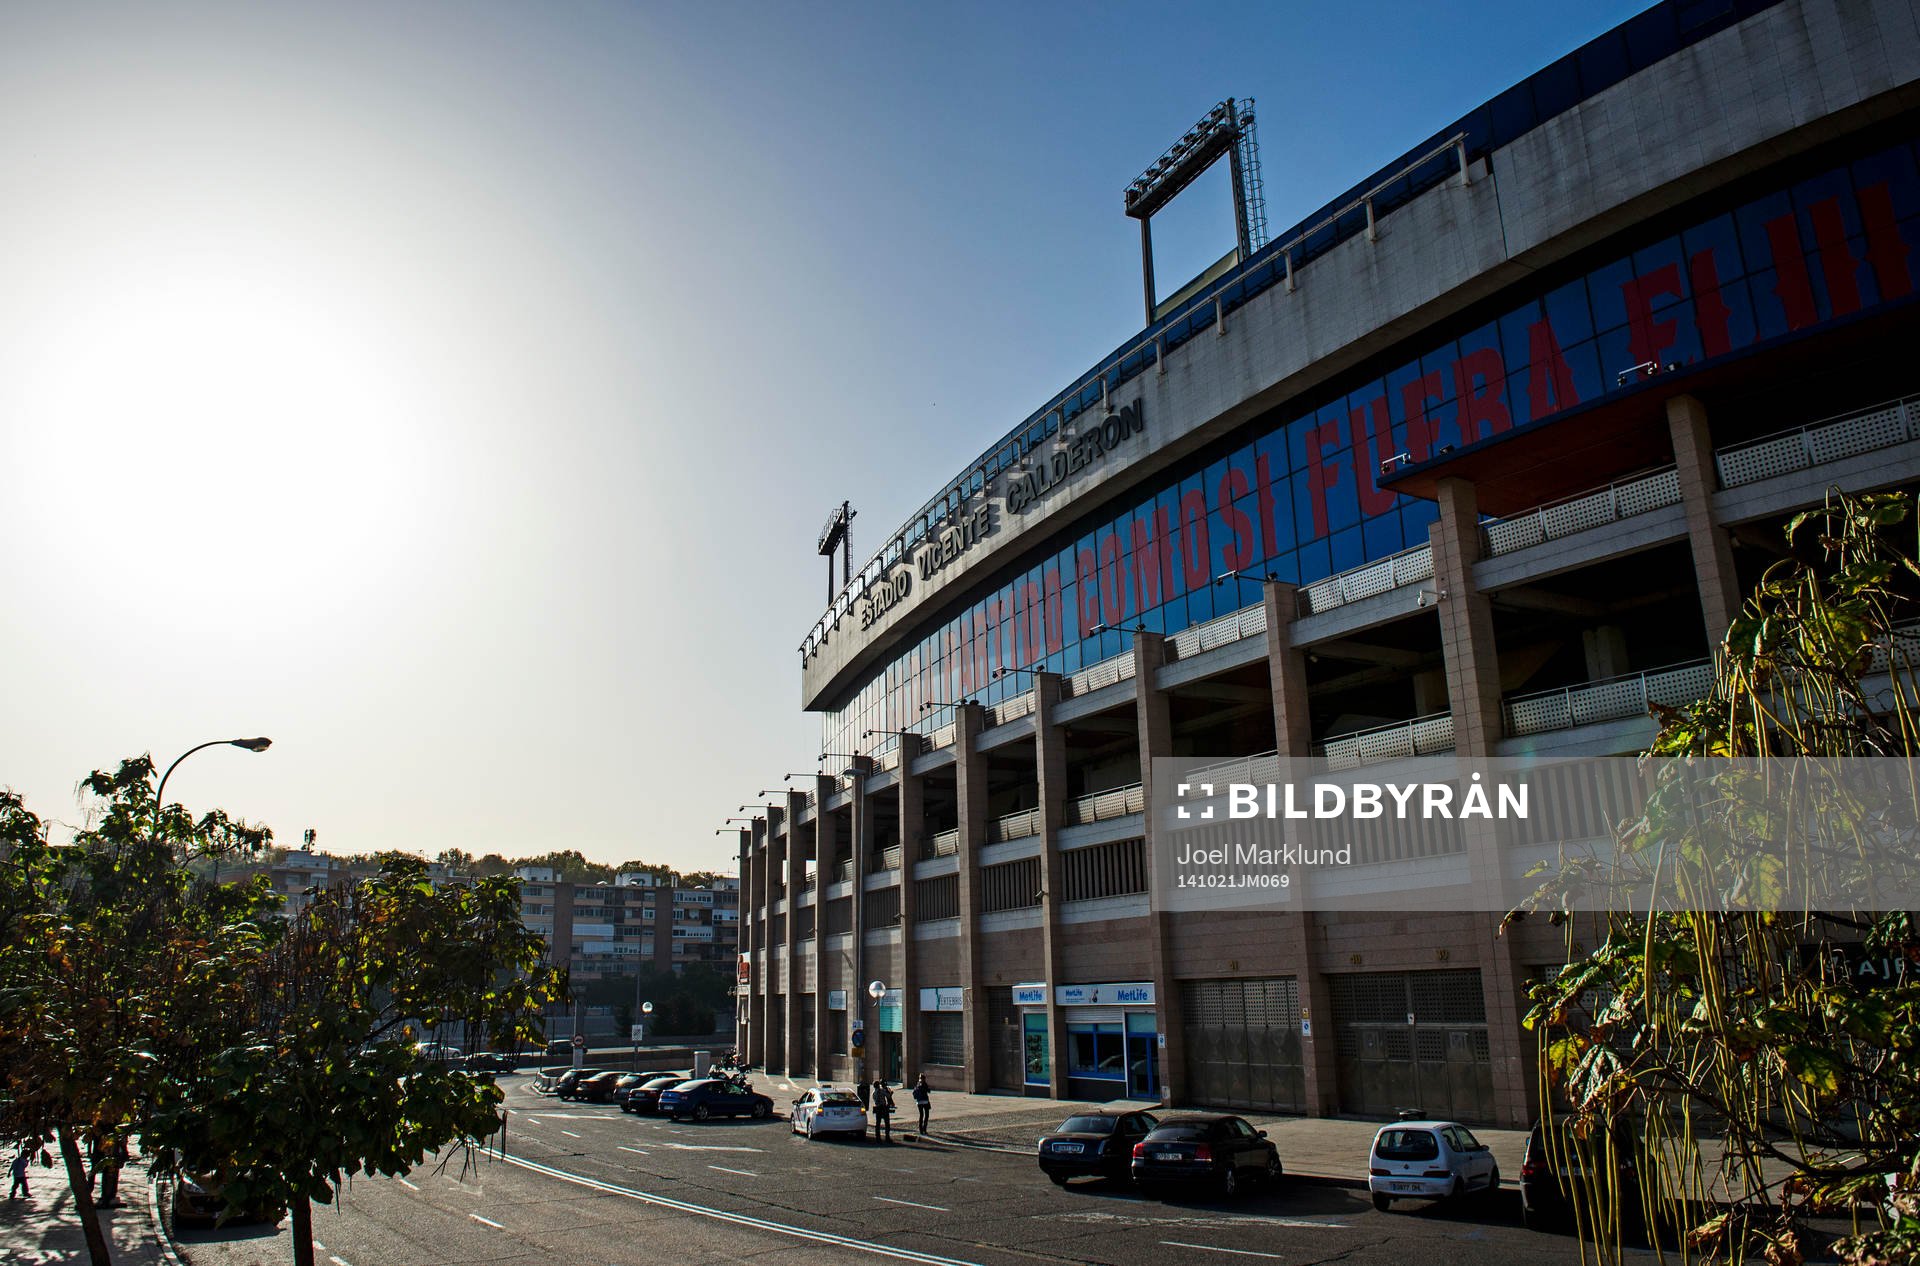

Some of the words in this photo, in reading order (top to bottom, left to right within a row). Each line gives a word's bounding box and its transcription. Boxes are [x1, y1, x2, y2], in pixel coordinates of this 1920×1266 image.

[861, 569, 908, 631] ESTADIO
[914, 502, 990, 580] VICENTE
[1019, 989, 1043, 1002] MetLife
[1117, 988, 1148, 1001] MetLife
